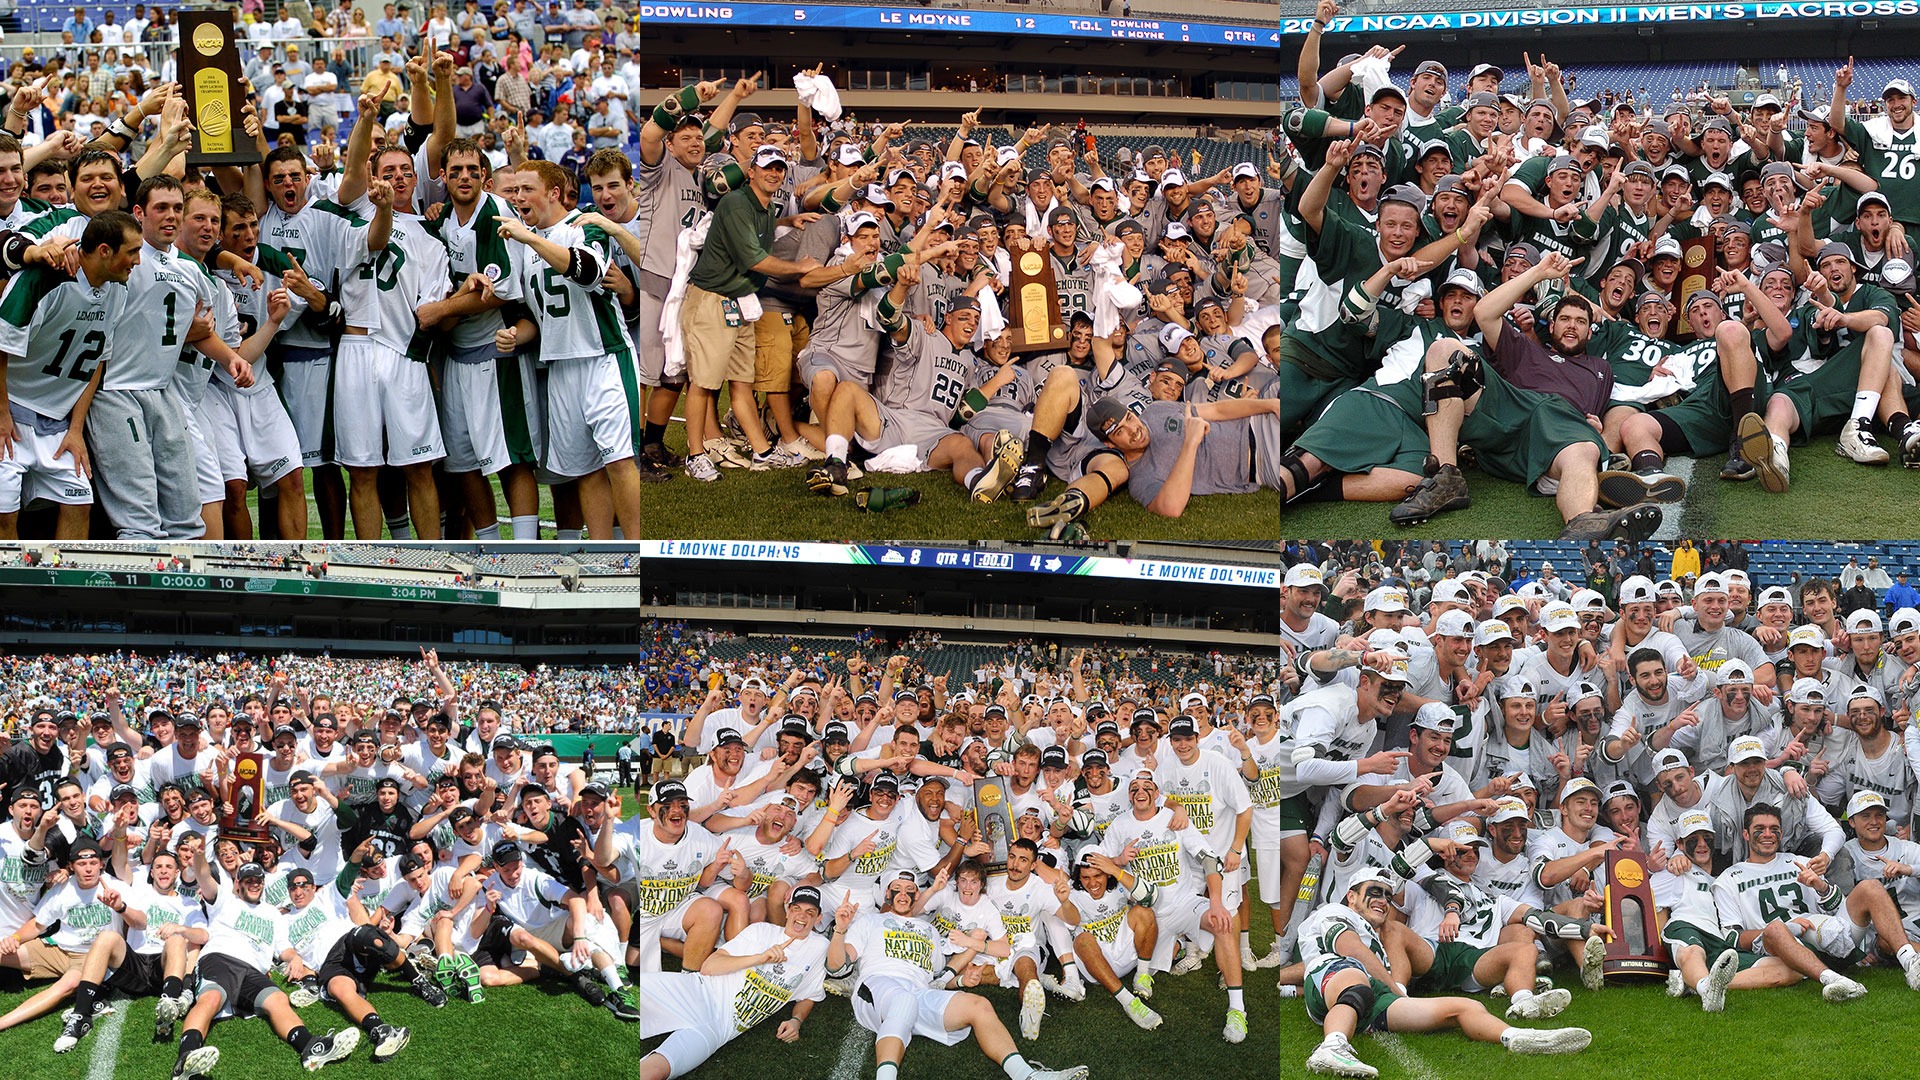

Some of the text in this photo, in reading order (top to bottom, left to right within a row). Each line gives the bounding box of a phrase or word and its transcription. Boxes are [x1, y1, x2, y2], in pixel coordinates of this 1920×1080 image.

[641, 5, 733, 19] DOWLING
[794, 10, 806, 20] 5
[880, 12, 902, 23] LE
[908, 13, 971, 26] MOYNE
[1110, 19, 1160, 30] DOWLING
[1181, 24, 1189, 32] 0
[1362, 14, 1450, 31] NCAA
[1460, 8, 1600, 28] DIVISION
[1610, 7, 1626, 22] II
[1638, 3, 1745, 21] MEN'S
[1756, 0, 1920, 18] LACROSS
[1111, 30, 1280, 42] LE MOYNE 0 QTR: 4
[1881, 152, 1917, 180] 26
[530, 267, 571, 319] 15
[162, 292, 178, 346] 1
[42, 328, 107, 382] 12
[1622, 339, 1662, 367] 30
[930, 372, 966, 410] 25
[127, 416, 140, 442] 1
[660, 542, 674, 555] LE
[679, 542, 728, 557] MOYNE
[909, 549, 922, 564] 8
[936, 552, 958, 565] QTR
[962, 553, 971, 566] 4
[1029, 555, 1041, 571] 4
[1140, 563, 1155, 577] LE
[1159, 564, 1205, 580] MOYNE
[51, 576, 55, 584] 1
[126, 574, 138, 585] 11
[161, 575, 206, 588] 0:00.0
[219, 578, 235, 589] 10
[391, 587, 417, 598] 3:04
[420, 589, 437, 599] PM
[303, 586, 310, 594] 0
[1129, 852, 1179, 872] NATIONAL
[1758, 882, 1809, 924] 43
